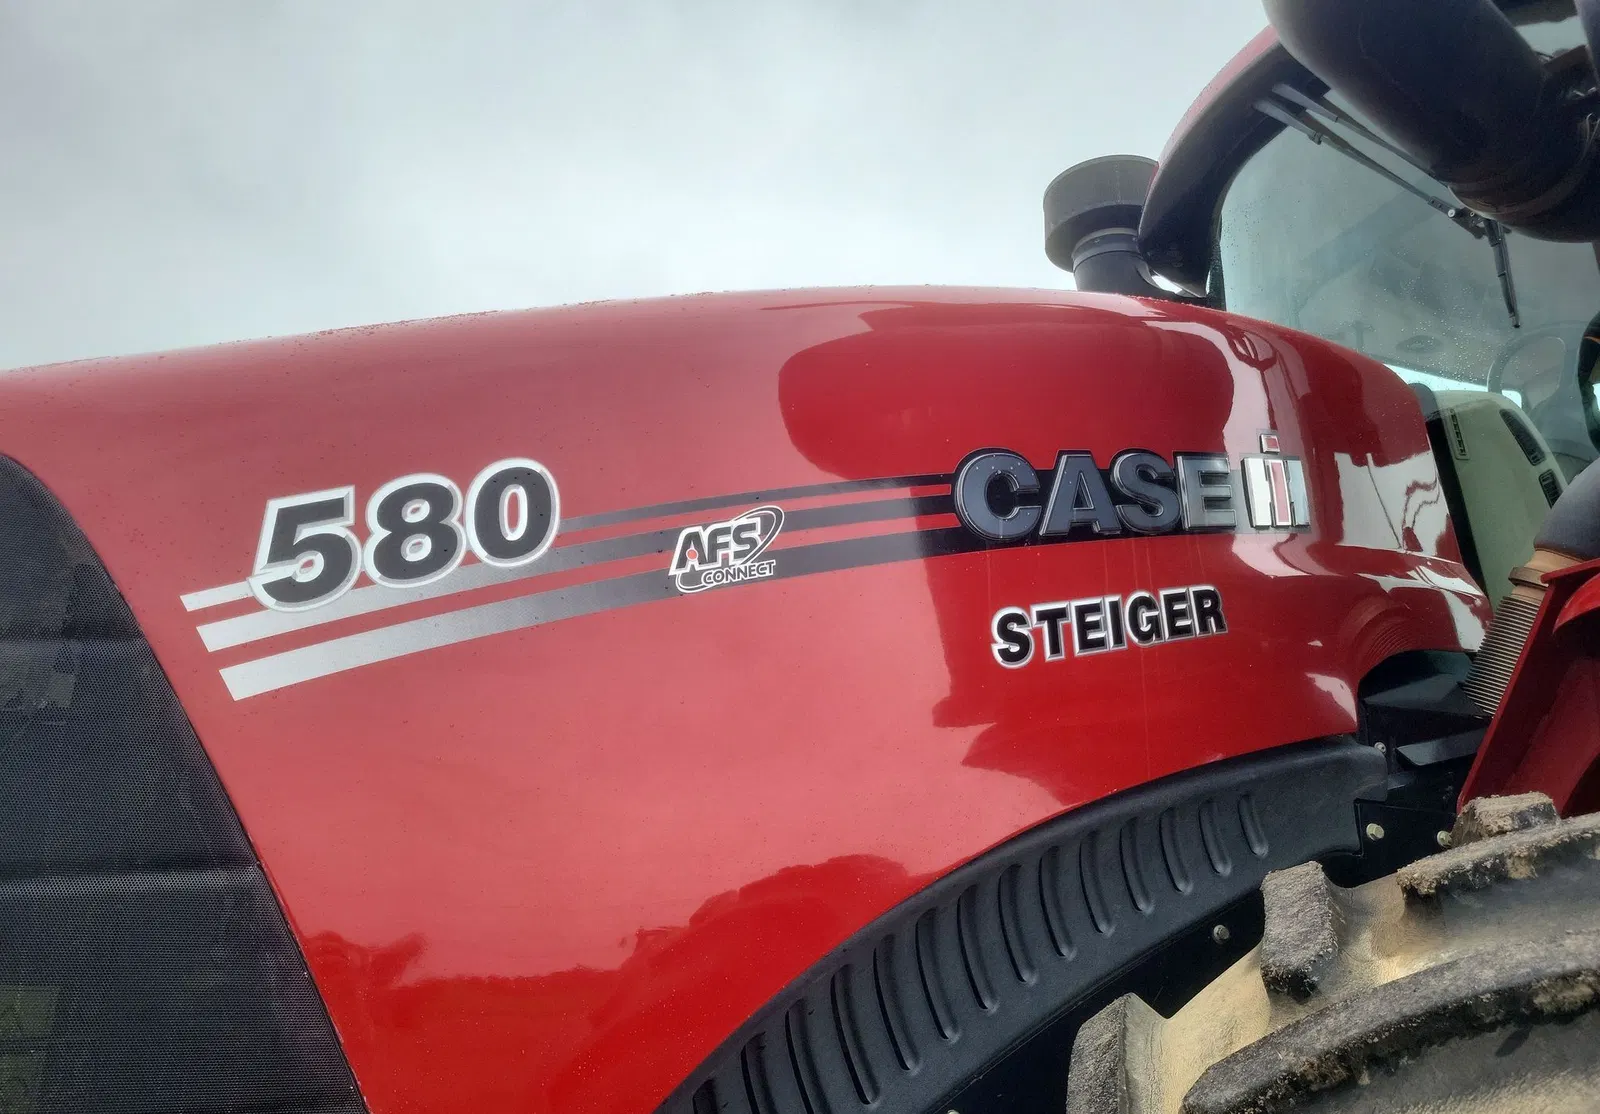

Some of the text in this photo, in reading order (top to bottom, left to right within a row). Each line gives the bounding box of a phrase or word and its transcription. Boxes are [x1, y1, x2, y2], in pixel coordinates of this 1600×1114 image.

[251, 459, 559, 611] 580
[956, 450, 1237, 540] CASE
[669, 517, 761, 575] AFS
[702, 560, 775, 585] CONNECT
[991, 586, 1228, 669] STEIGER
